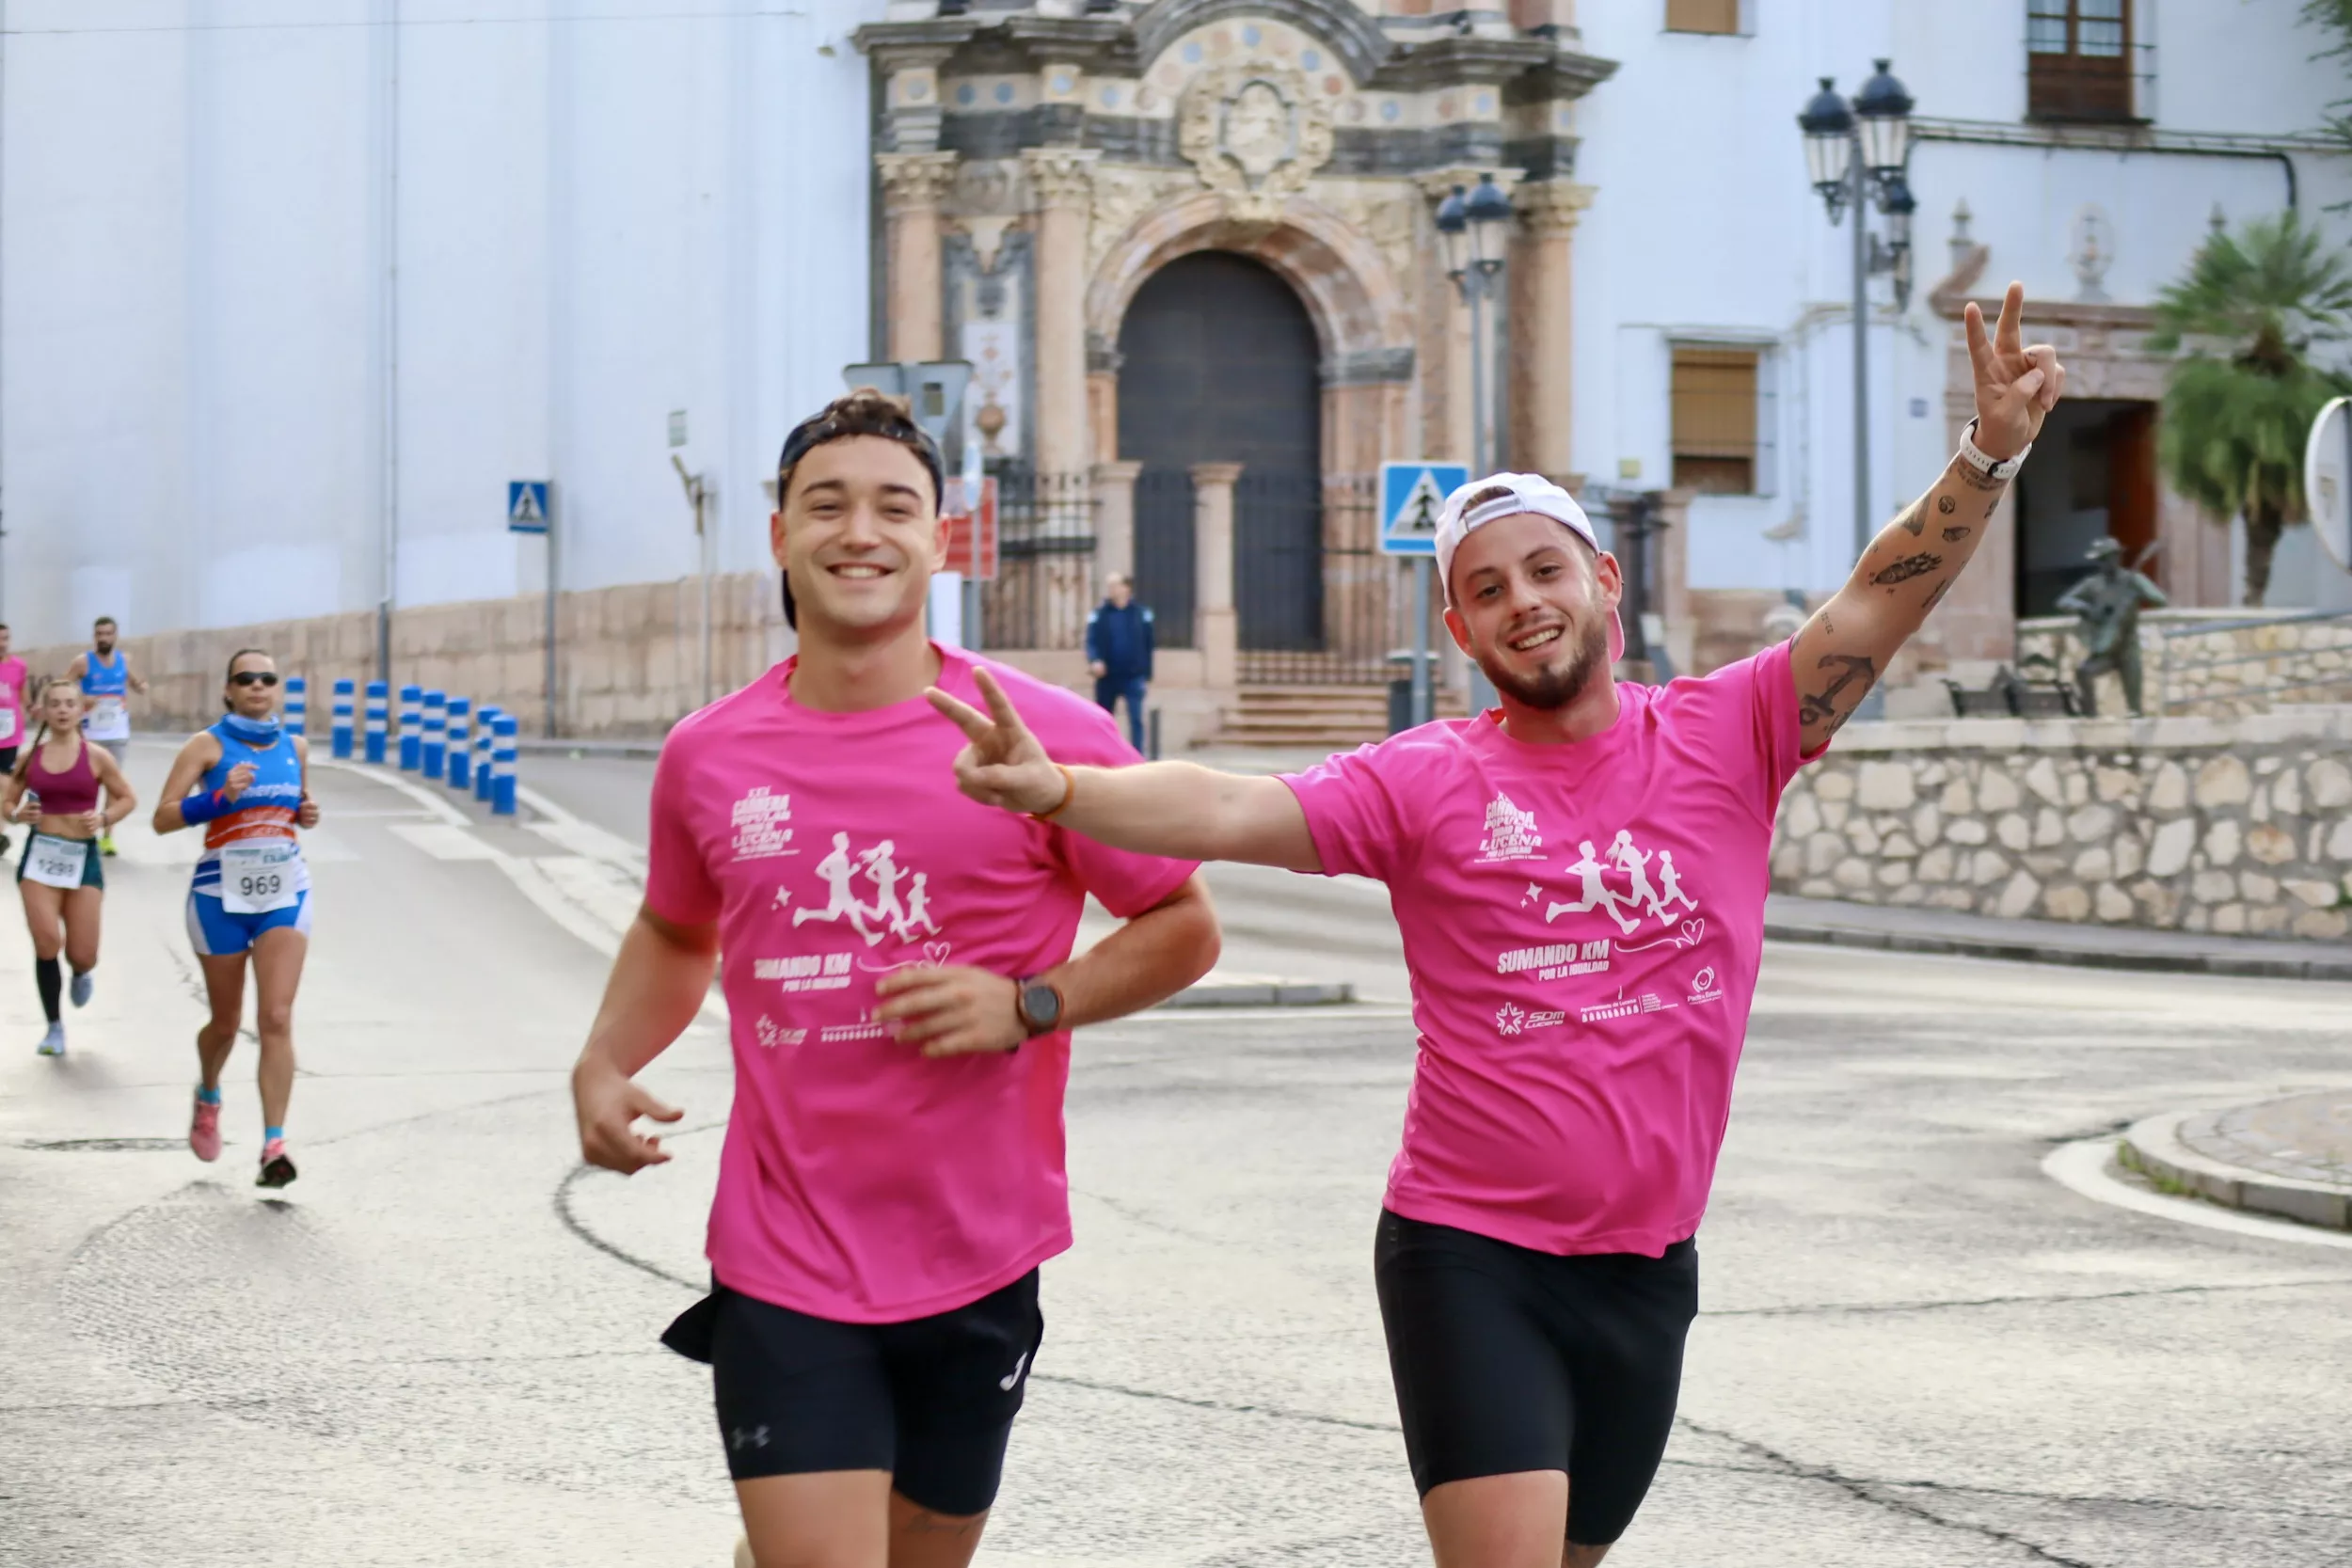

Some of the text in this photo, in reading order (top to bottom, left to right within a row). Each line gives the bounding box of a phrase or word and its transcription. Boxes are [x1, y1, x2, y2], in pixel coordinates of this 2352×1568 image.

[1479, 834, 1542, 851] LUCENA
[241, 875, 280, 896] 969
[824, 952, 852, 975] KM
[1497, 938, 1610, 974] SUMANDO KM
[1538, 960, 1610, 982] POR LA IGUALDAD
